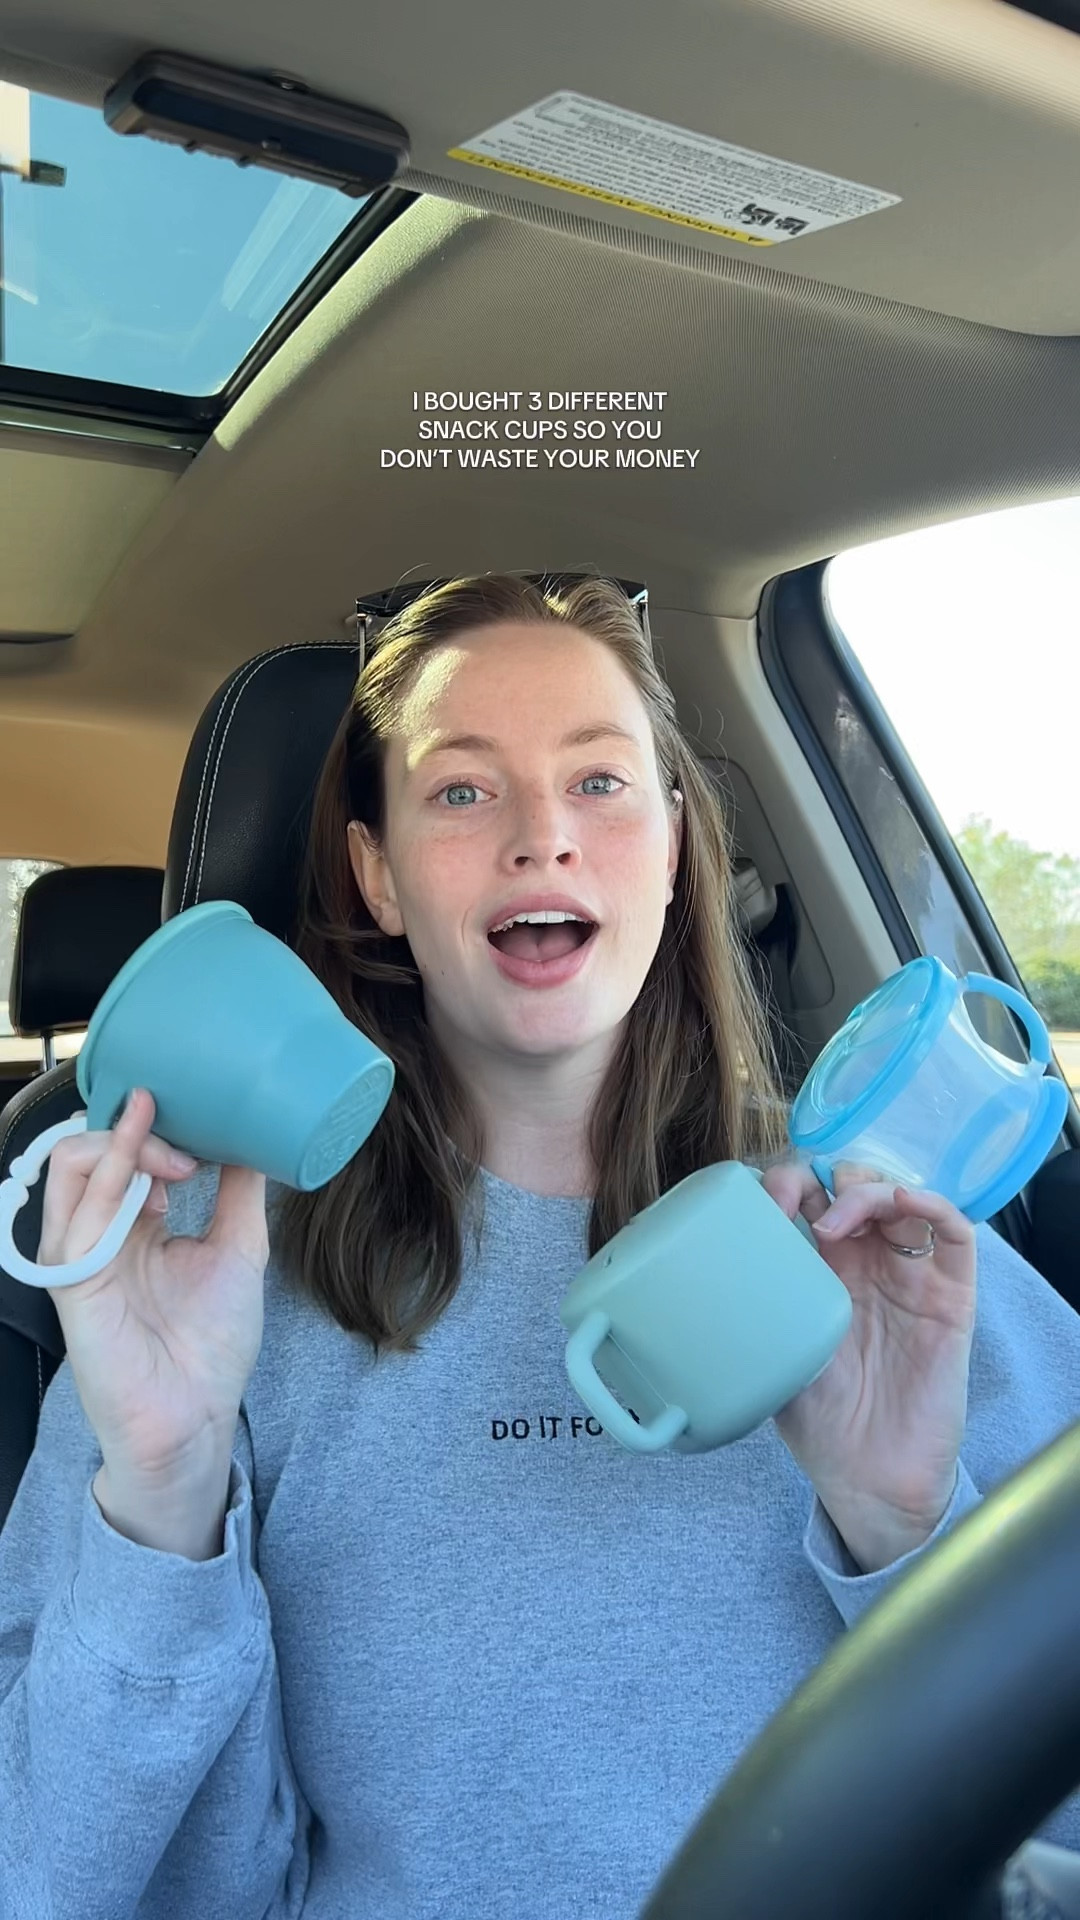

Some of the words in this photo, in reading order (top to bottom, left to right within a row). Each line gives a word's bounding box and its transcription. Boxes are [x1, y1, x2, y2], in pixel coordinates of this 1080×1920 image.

[491, 1418, 530, 1440] DO
[539, 1415, 562, 1439] IT
[570, 1415, 604, 1438] FO
